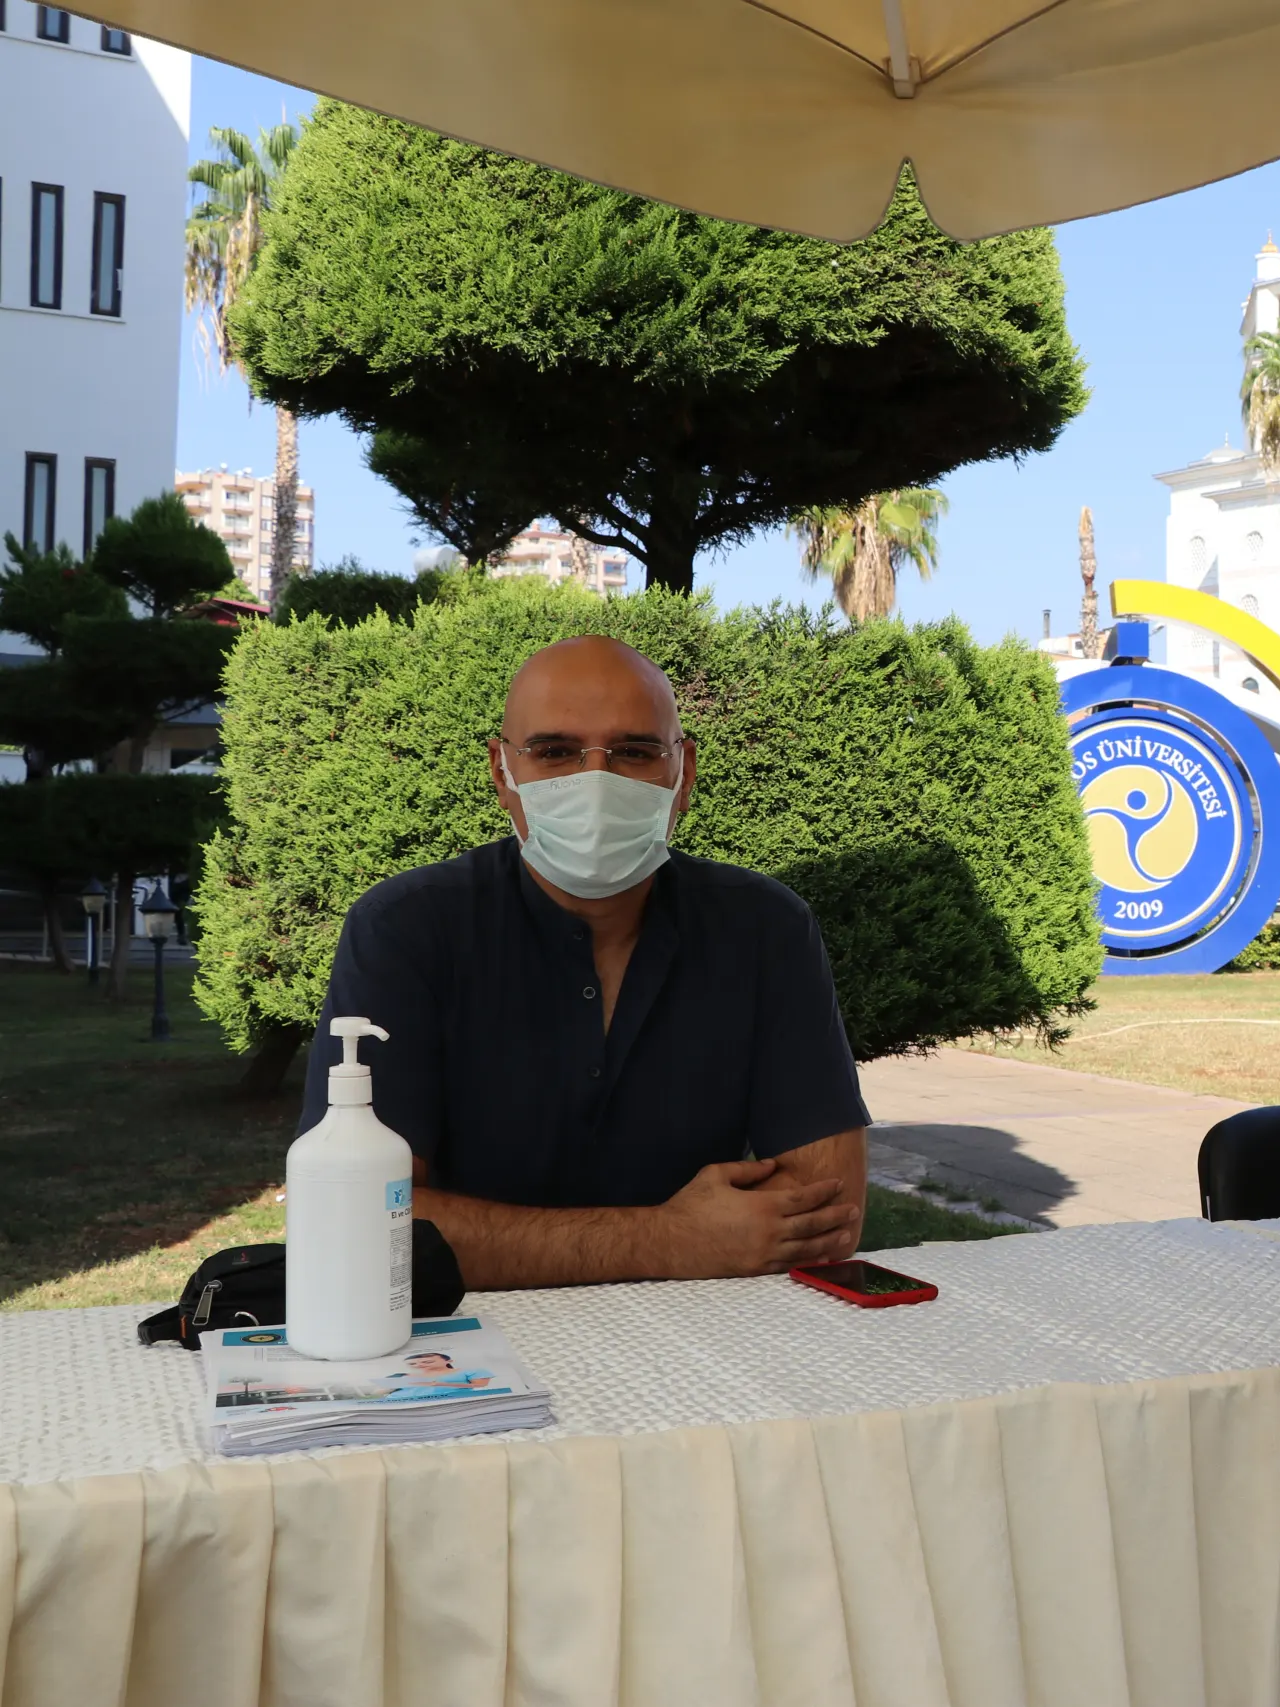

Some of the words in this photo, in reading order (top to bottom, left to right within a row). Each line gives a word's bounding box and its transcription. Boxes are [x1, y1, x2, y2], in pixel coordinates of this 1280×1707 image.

[1071, 751, 1098, 780] OS
[1097, 735, 1227, 821] ÜNİVERSİTESİ
[1114, 899, 1163, 919] 2009
